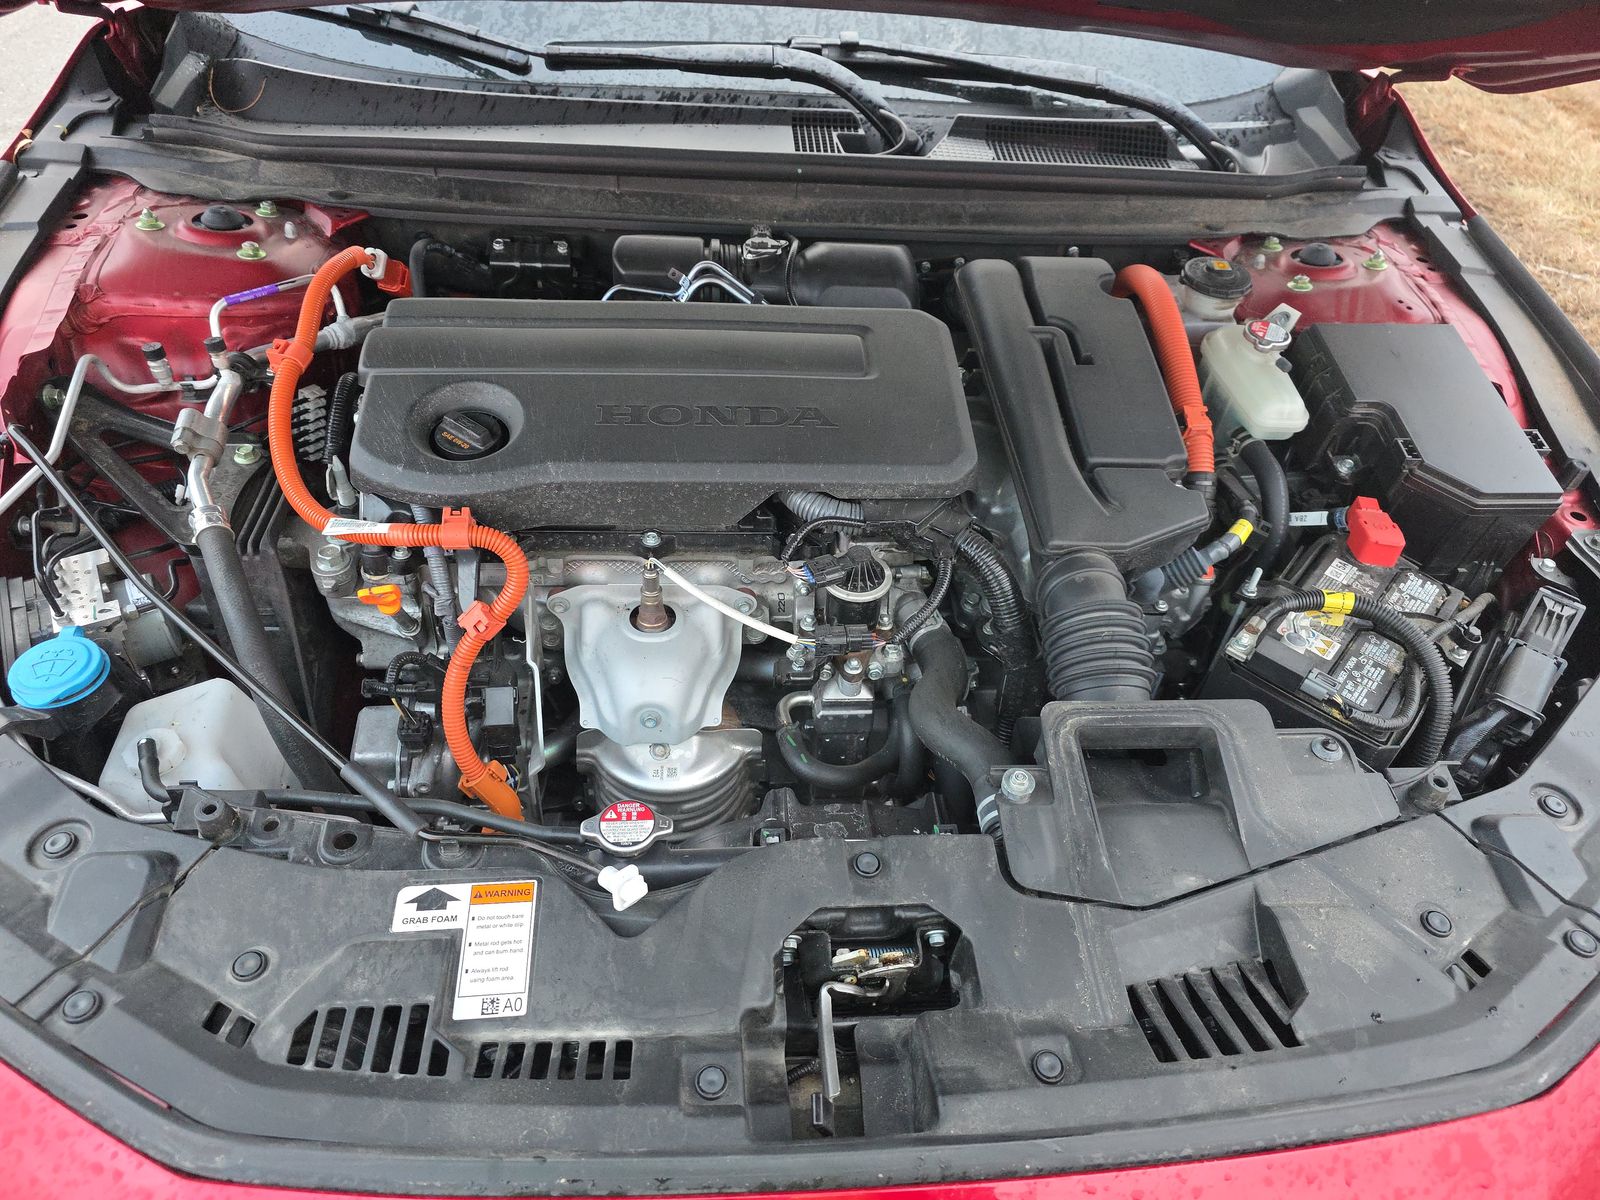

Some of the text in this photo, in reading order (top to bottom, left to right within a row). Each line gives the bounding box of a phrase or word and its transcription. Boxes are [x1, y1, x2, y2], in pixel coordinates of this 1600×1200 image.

[594, 404, 840, 428] HONDA
[777, 592, 786, 613] 220
[484, 888, 532, 899] WARNING
[402, 914, 458, 925] GRAB FOAM
[502, 997, 523, 1013] A0
